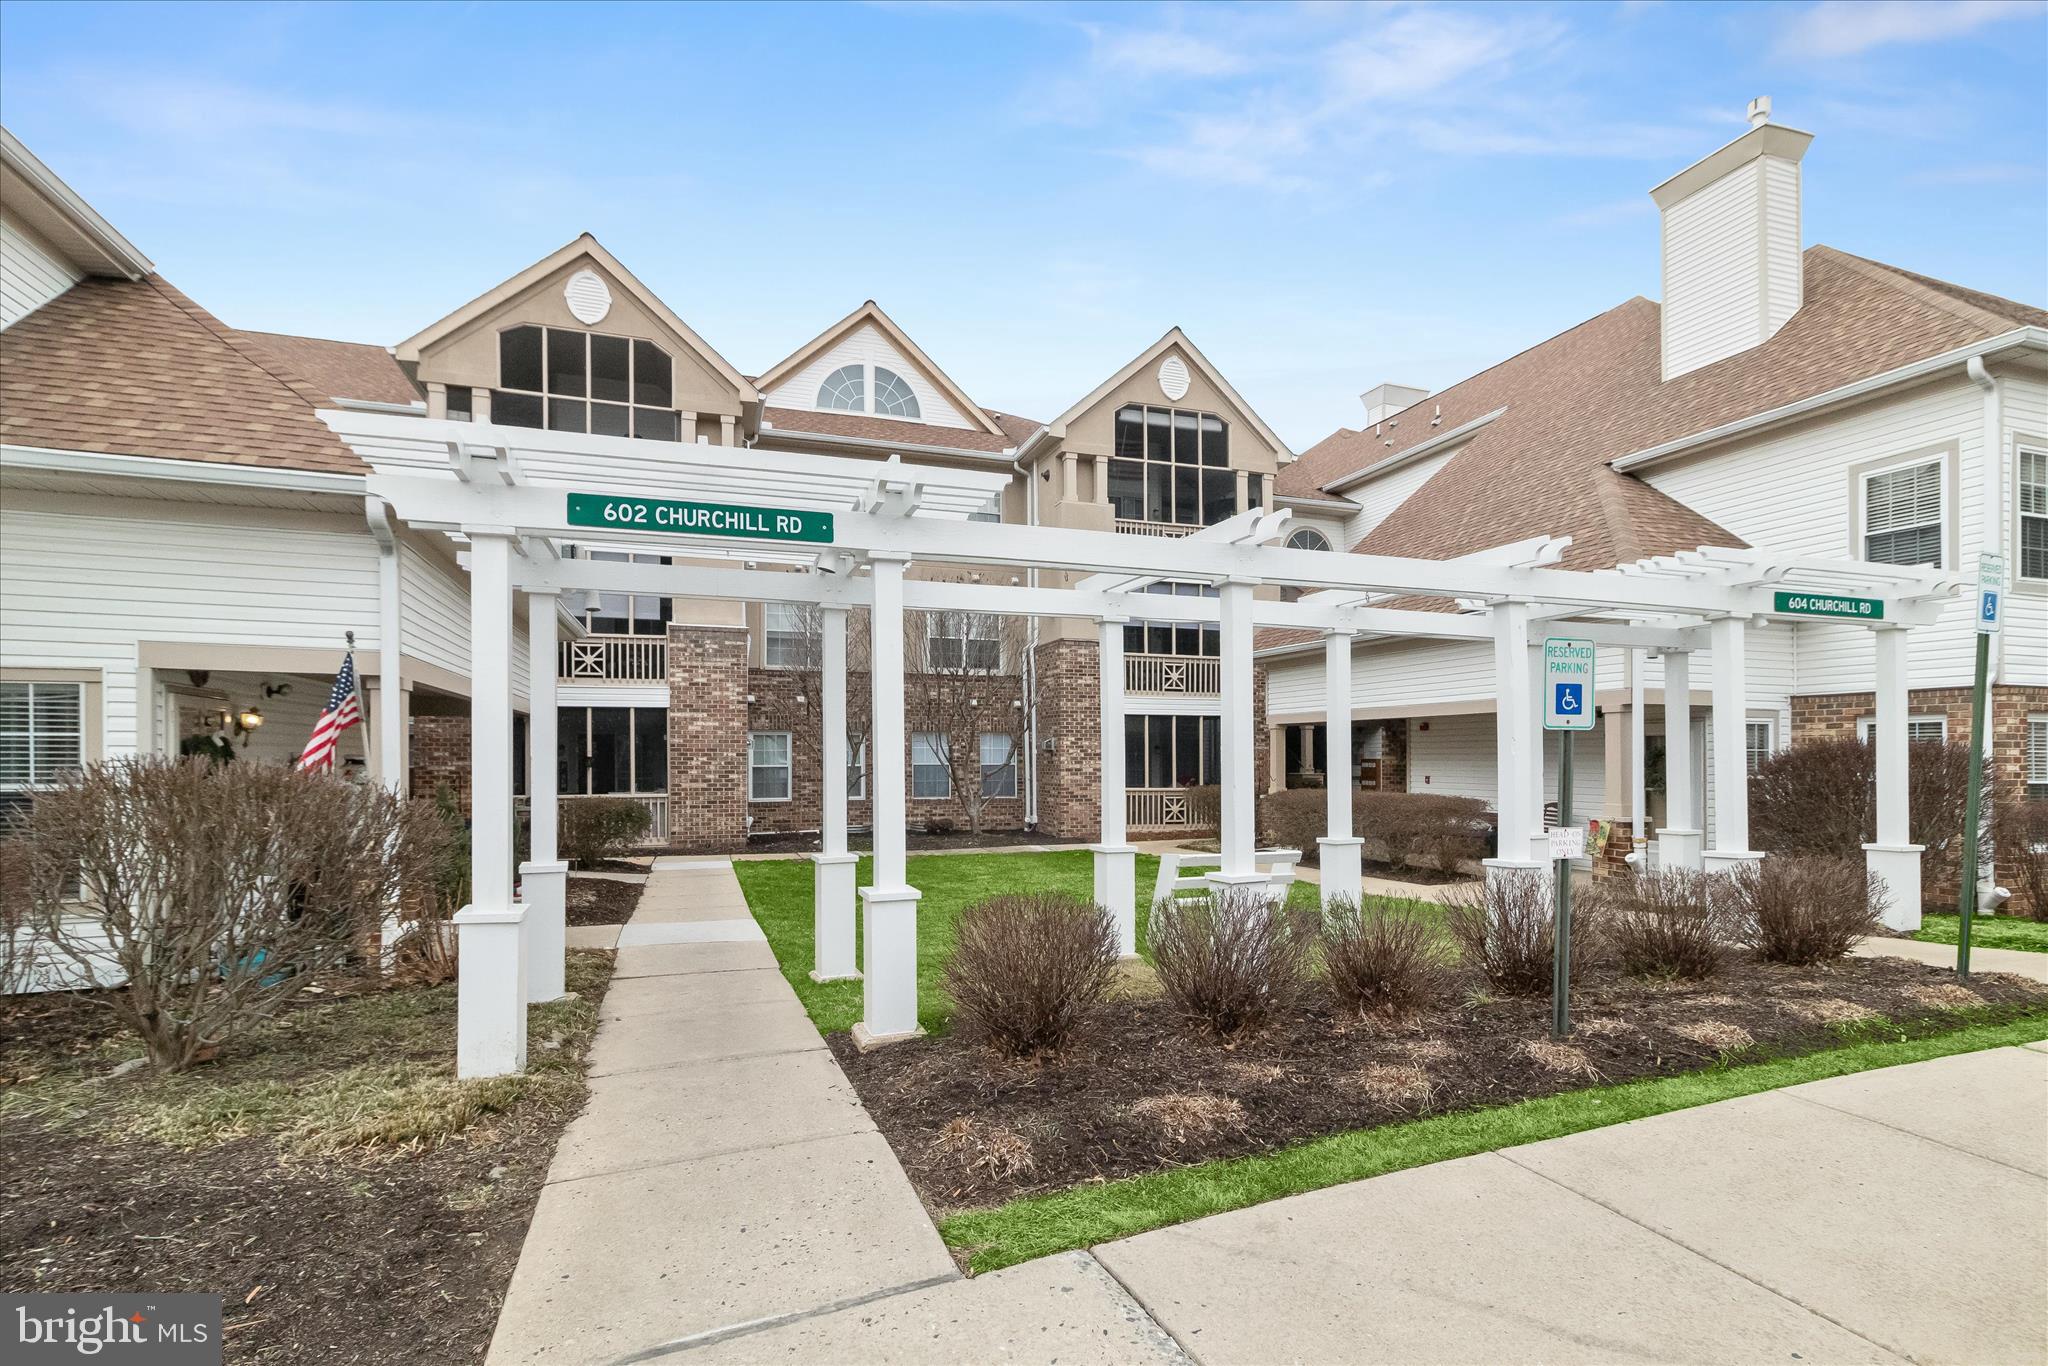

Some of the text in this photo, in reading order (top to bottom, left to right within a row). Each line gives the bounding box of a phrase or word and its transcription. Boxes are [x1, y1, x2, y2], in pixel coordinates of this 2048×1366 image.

[603, 502, 802, 534] 602 CHURCHILL RD
[1788, 597, 1872, 614] 604 CHURCHILL RD
[1547, 646, 1592, 659] RESERVED
[1550, 661, 1589, 674] PARKING
[1550, 839, 1581, 847] PARKING
[1556, 848, 1574, 856] ONLY
